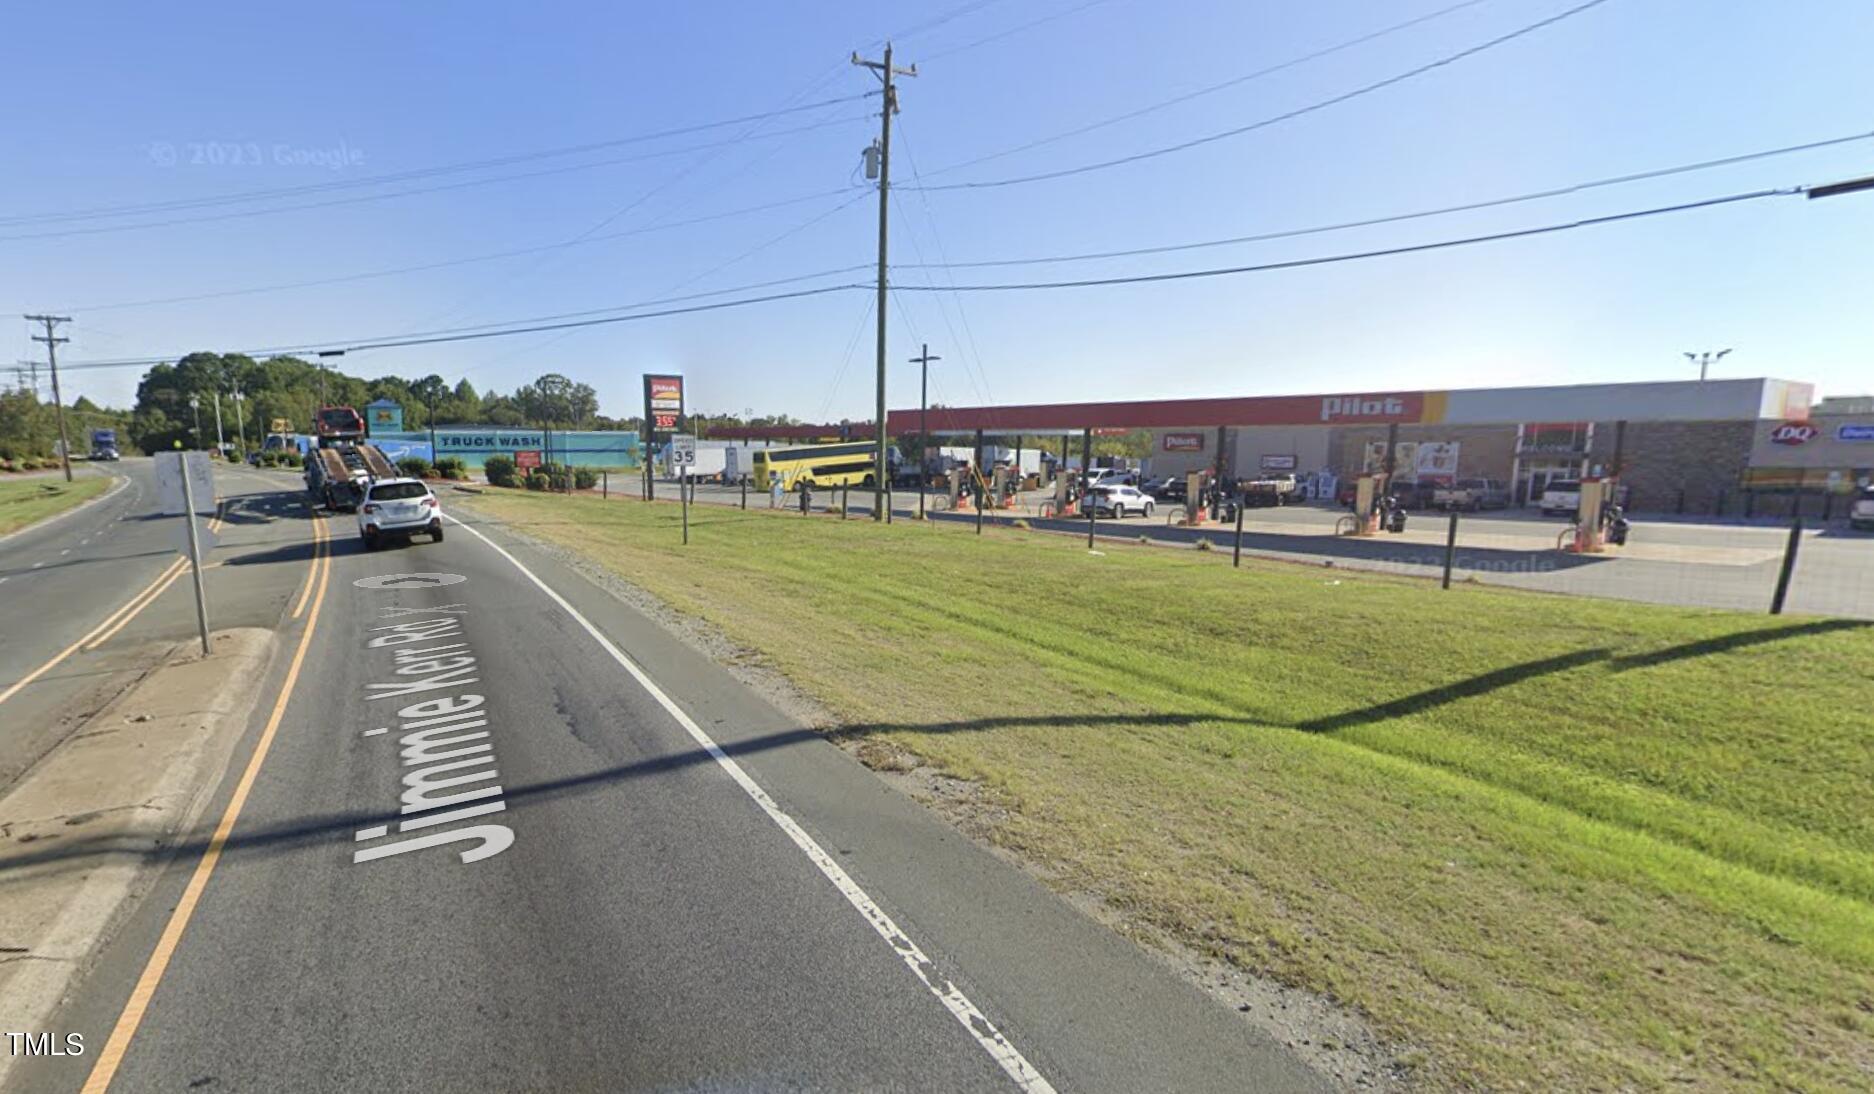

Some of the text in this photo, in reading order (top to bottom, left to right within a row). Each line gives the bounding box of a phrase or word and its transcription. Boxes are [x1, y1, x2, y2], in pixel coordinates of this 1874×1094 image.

[1321, 397, 1404, 421] Pilot
[1778, 427, 1810, 440] DQ
[441, 437, 542, 447] TRUCK WASH
[674, 450, 694, 463] 35
